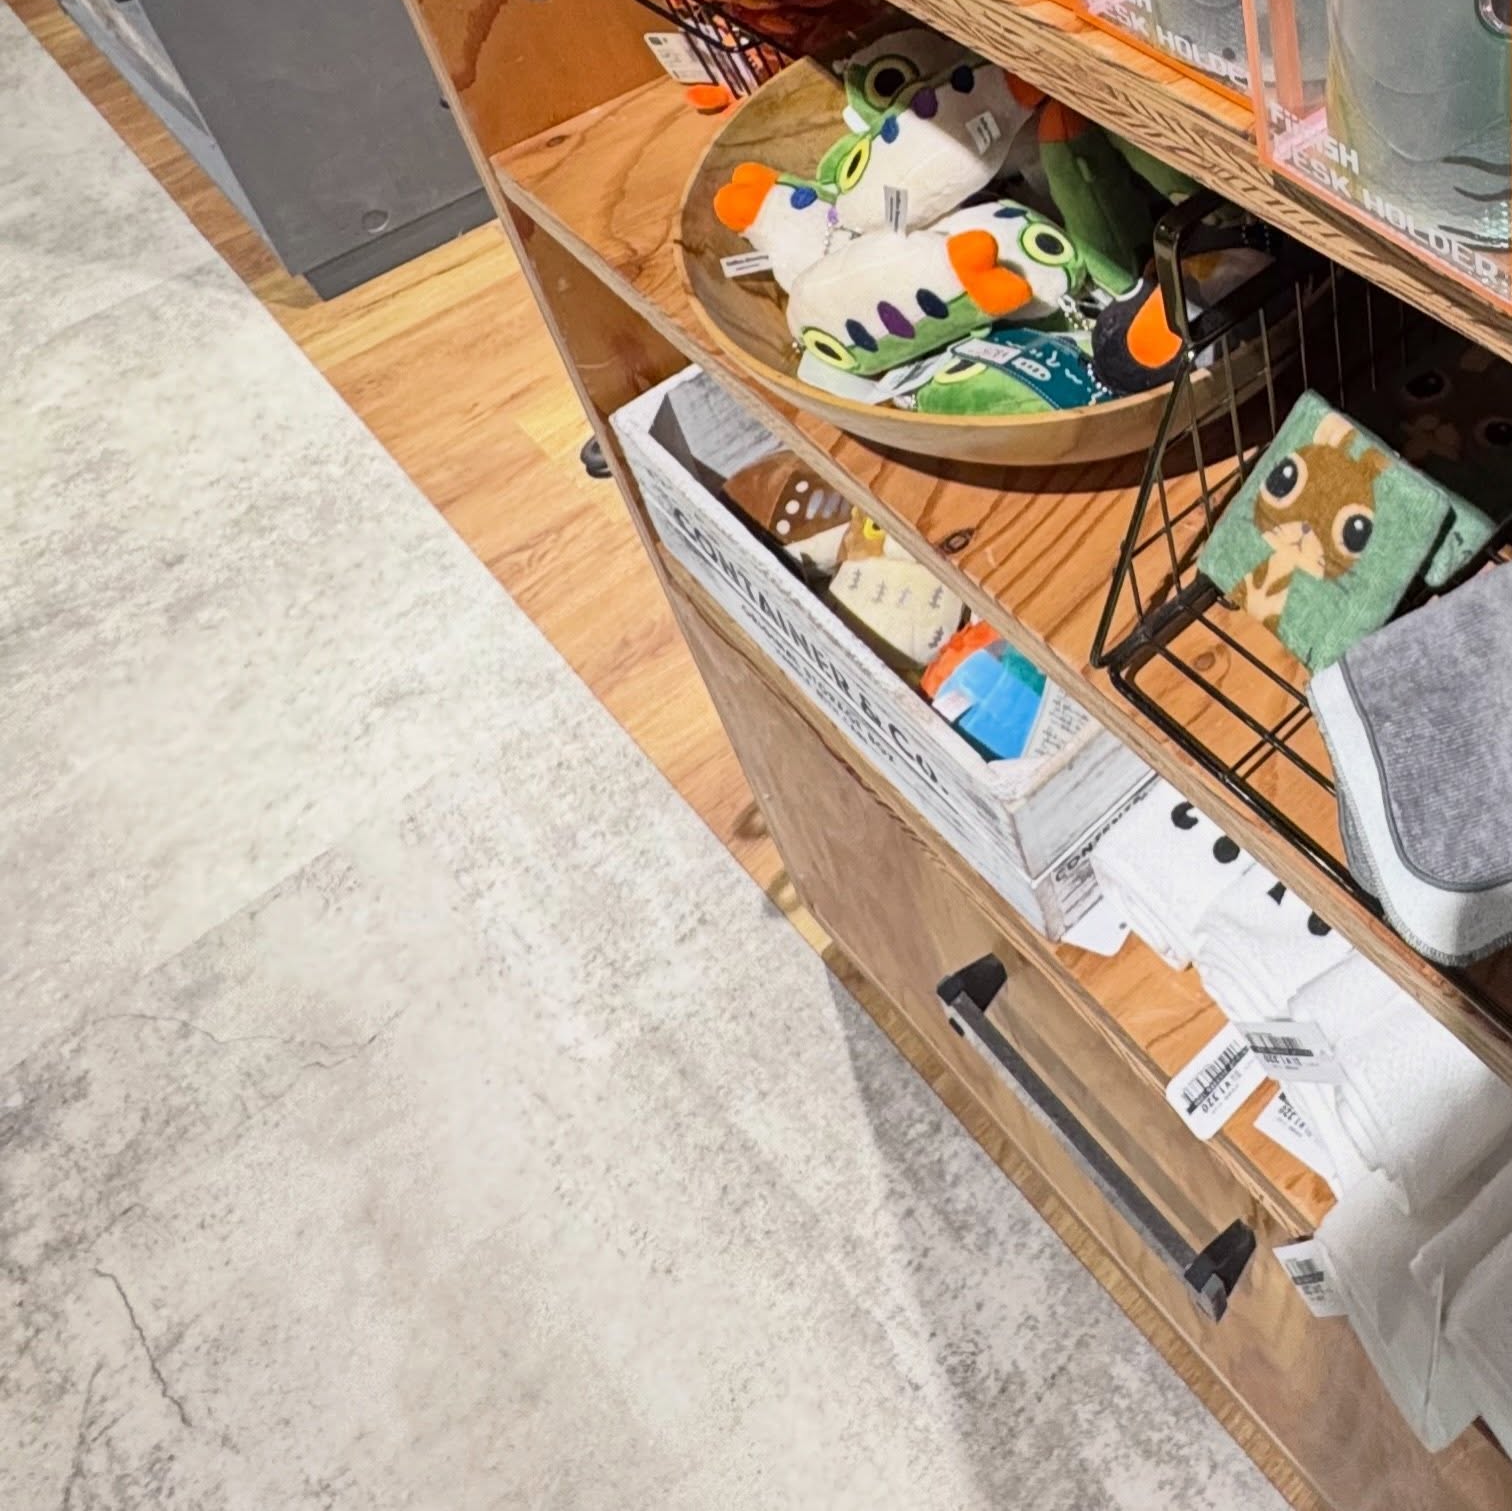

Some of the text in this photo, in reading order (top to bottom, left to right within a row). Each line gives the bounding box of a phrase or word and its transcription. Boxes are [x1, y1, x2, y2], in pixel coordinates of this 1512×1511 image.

[1156, 23, 1249, 90] HOLDE
[1362, 188, 1499, 285] HOLDER
[673, 507, 851, 698] CONTAINER
